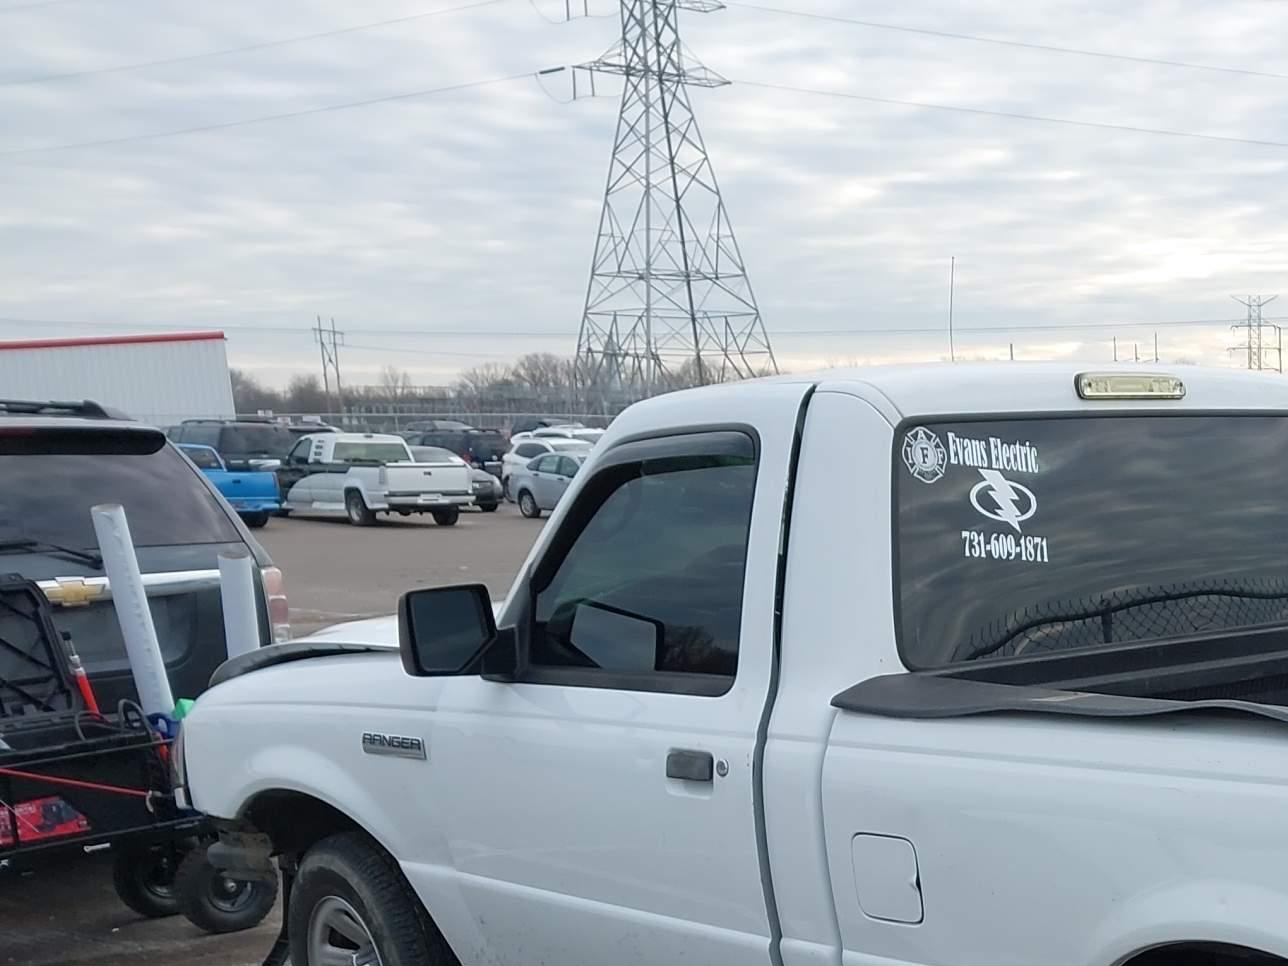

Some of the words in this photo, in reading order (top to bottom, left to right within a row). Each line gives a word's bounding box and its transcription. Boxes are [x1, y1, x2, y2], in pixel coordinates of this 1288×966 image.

[948, 432, 988, 468] Evans
[989, 437, 1039, 473] Electric
[962, 531, 1049, 562] 731-609-1871
[362, 732, 422, 751] RANGER
